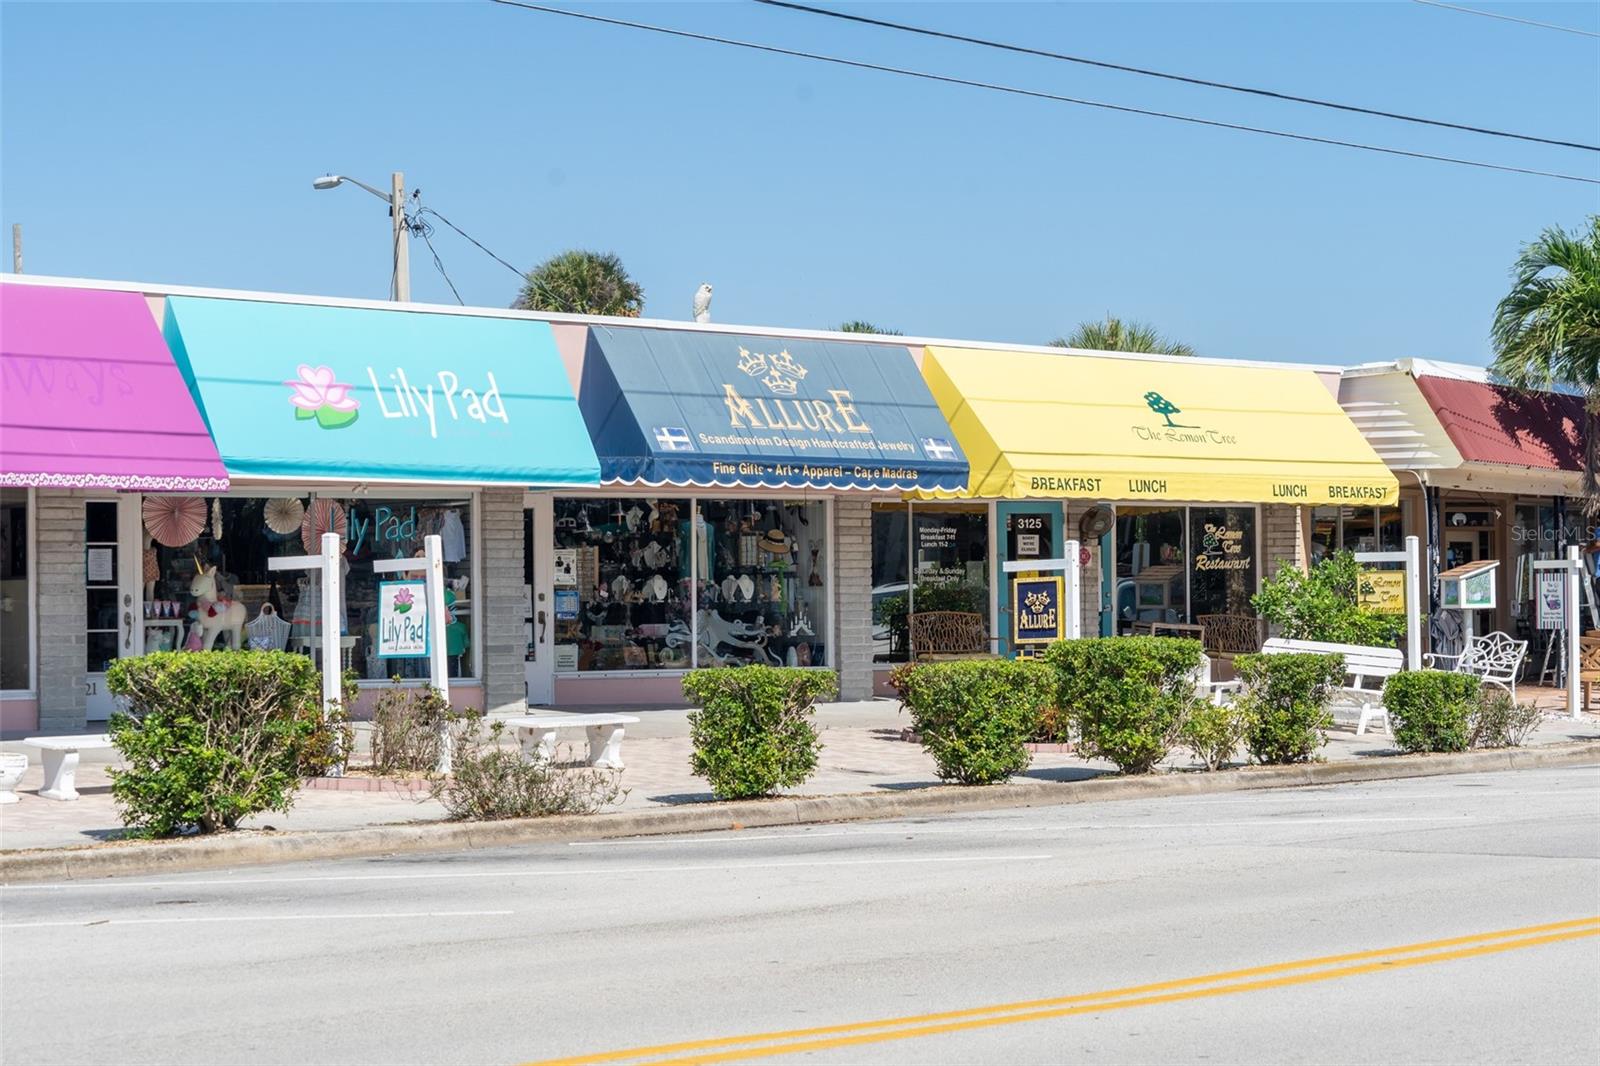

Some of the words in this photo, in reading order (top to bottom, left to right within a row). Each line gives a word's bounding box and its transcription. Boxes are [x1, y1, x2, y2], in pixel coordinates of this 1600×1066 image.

[367, 366, 437, 439] Lily
[437, 371, 509, 424] Pad
[722, 383, 873, 434] ALLURE
[699, 433, 774, 447] Scandinavian
[775, 438, 811, 450] Design
[813, 438, 876, 450] Handcrafted
[877, 440, 915, 453] Jewelry
[1131, 426, 1162, 440] The
[1164, 428, 1207, 444] Lemon
[1205, 430, 1237, 444] Tree
[713, 462, 736, 474] Fine
[775, 464, 792, 476] Art
[802, 464, 843, 479] Apparel
[882, 467, 918, 480] Madras
[1031, 476, 1102, 492] BREAKFAST
[1129, 479, 1167, 494] LUNCH
[1272, 484, 1308, 497] LUNCH
[1328, 486, 1388, 499] BREAKFAST
[376, 505, 417, 542] Pad
[919, 527, 957, 535] Monday-Friday
[1018, 518, 1042, 529] 3125
[1195, 555, 1250, 570] Restaurant
[1019, 608, 1056, 629] ALLURE
[382, 616, 402, 651] Lily
[404, 616, 424, 643] Pad
